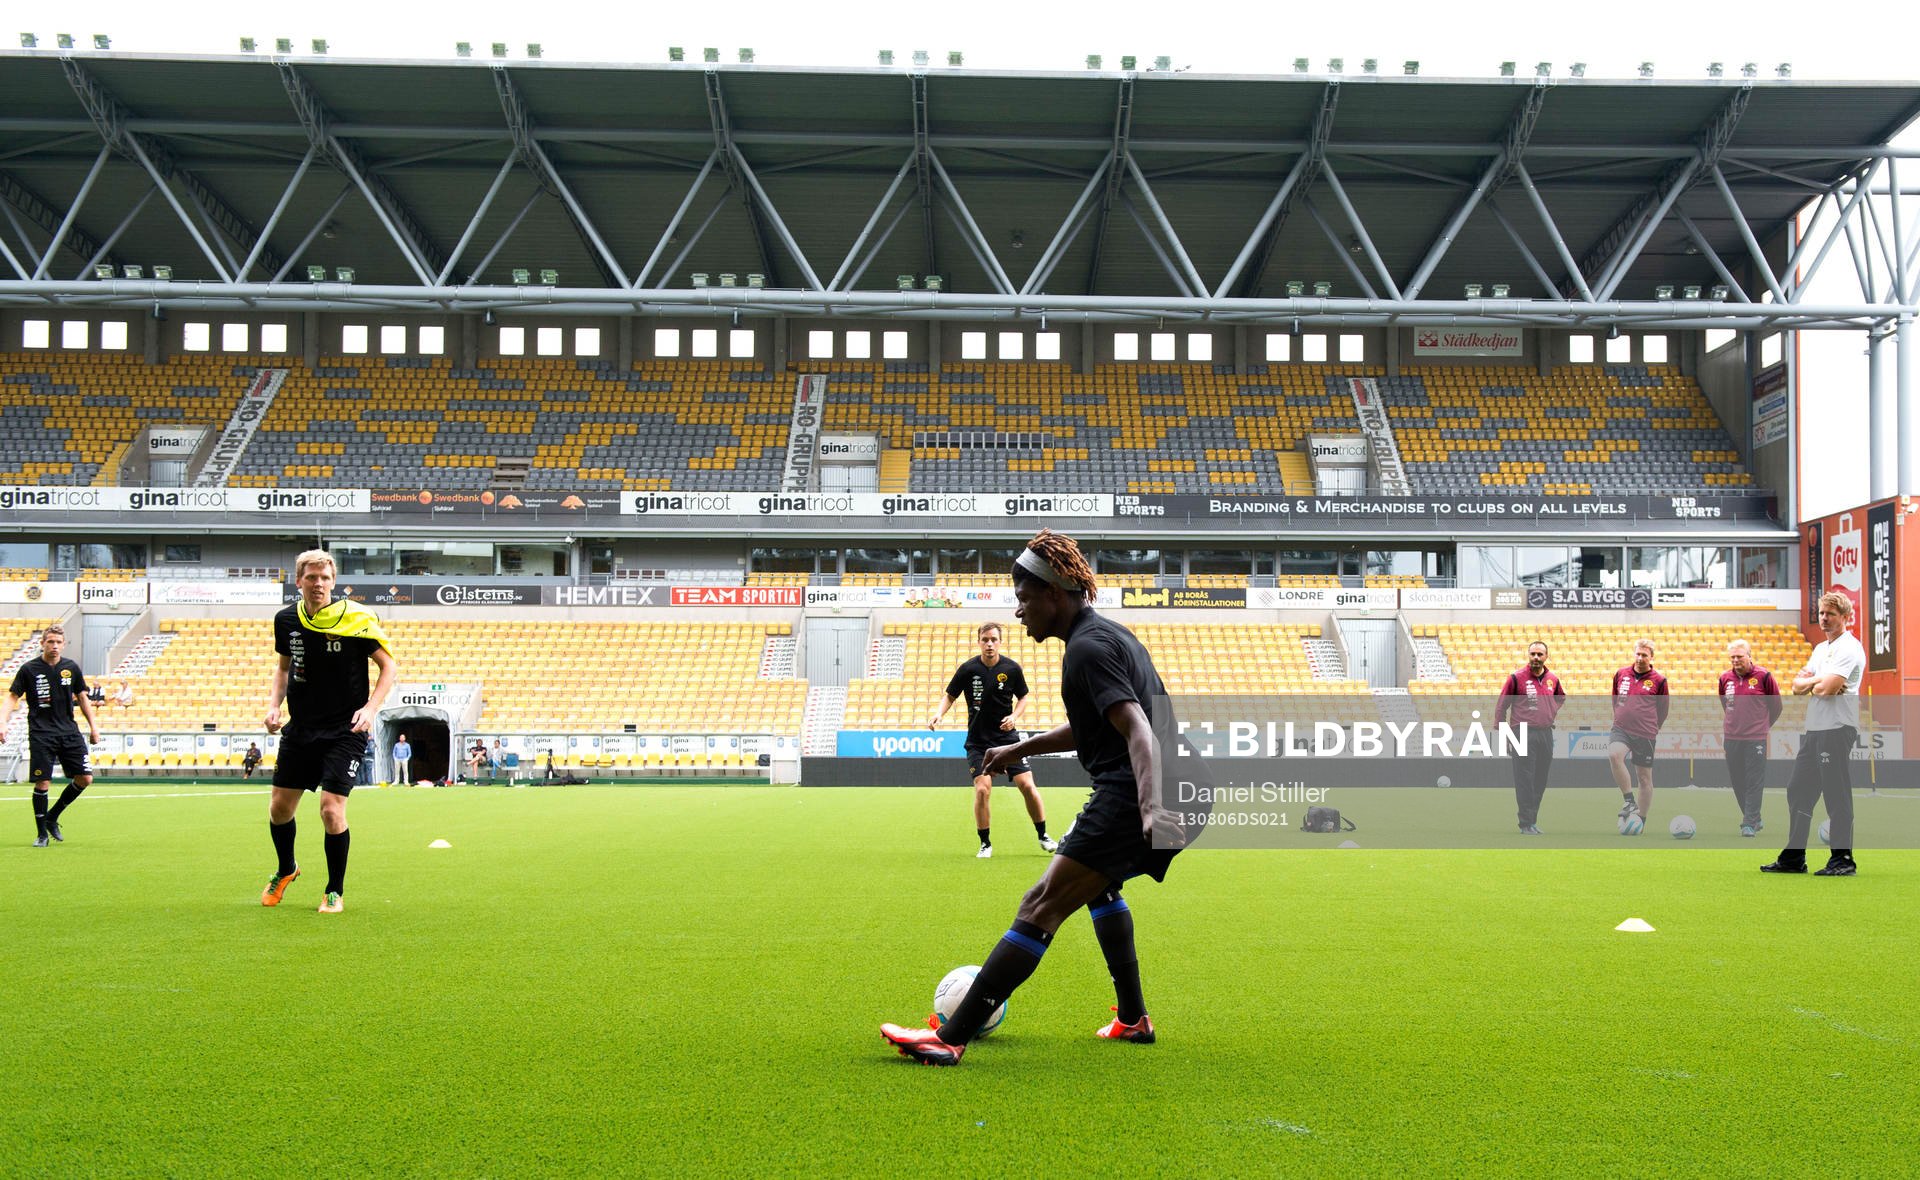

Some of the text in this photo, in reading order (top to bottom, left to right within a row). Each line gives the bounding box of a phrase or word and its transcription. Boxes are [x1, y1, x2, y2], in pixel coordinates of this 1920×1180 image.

[1442, 334, 1518, 350] Städkedjan
[130, 489, 228, 509] ginatricot
[258, 490, 356, 510] ginatricot
[372, 494, 418, 502] Swedbank
[434, 494, 480, 502] Swedbank
[635, 493, 730, 513] ginatricot
[759, 494, 854, 513] ginatricot
[882, 495, 976, 514] ginatricot
[1005, 495, 1099, 514] ginatricot
[1116, 496, 1140, 505] NEB
[1672, 498, 1696, 507] NEB
[1119, 506, 1164, 515] SPORTS
[1296, 501, 1309, 513] &
[1316, 500, 1425, 513] MERCHANDISE
[1457, 503, 1505, 514] CLUBS
[1511, 503, 1533, 514] ON
[1539, 503, 1567, 514] ALL
[1573, 503, 1626, 514] LEVELS
[1676, 507, 1720, 517] SPORTS
[1834, 546, 1858, 574] City
[556, 586, 656, 605] HEMTEX
[1185, 591, 1208, 599] BORÅS
[1874, 522, 1884, 655] 8848
[676, 589, 796, 603] TEAM SPORTIA
[1174, 599, 1245, 607] RÖRINSTALLATIONER
[1552, 590, 1626, 602] S.A BYGG
[326, 641, 342, 652] 10
[1582, 741, 1608, 750] BALLA
[1856, 734, 1884, 749] LS
[350, 761, 360, 771] 10
